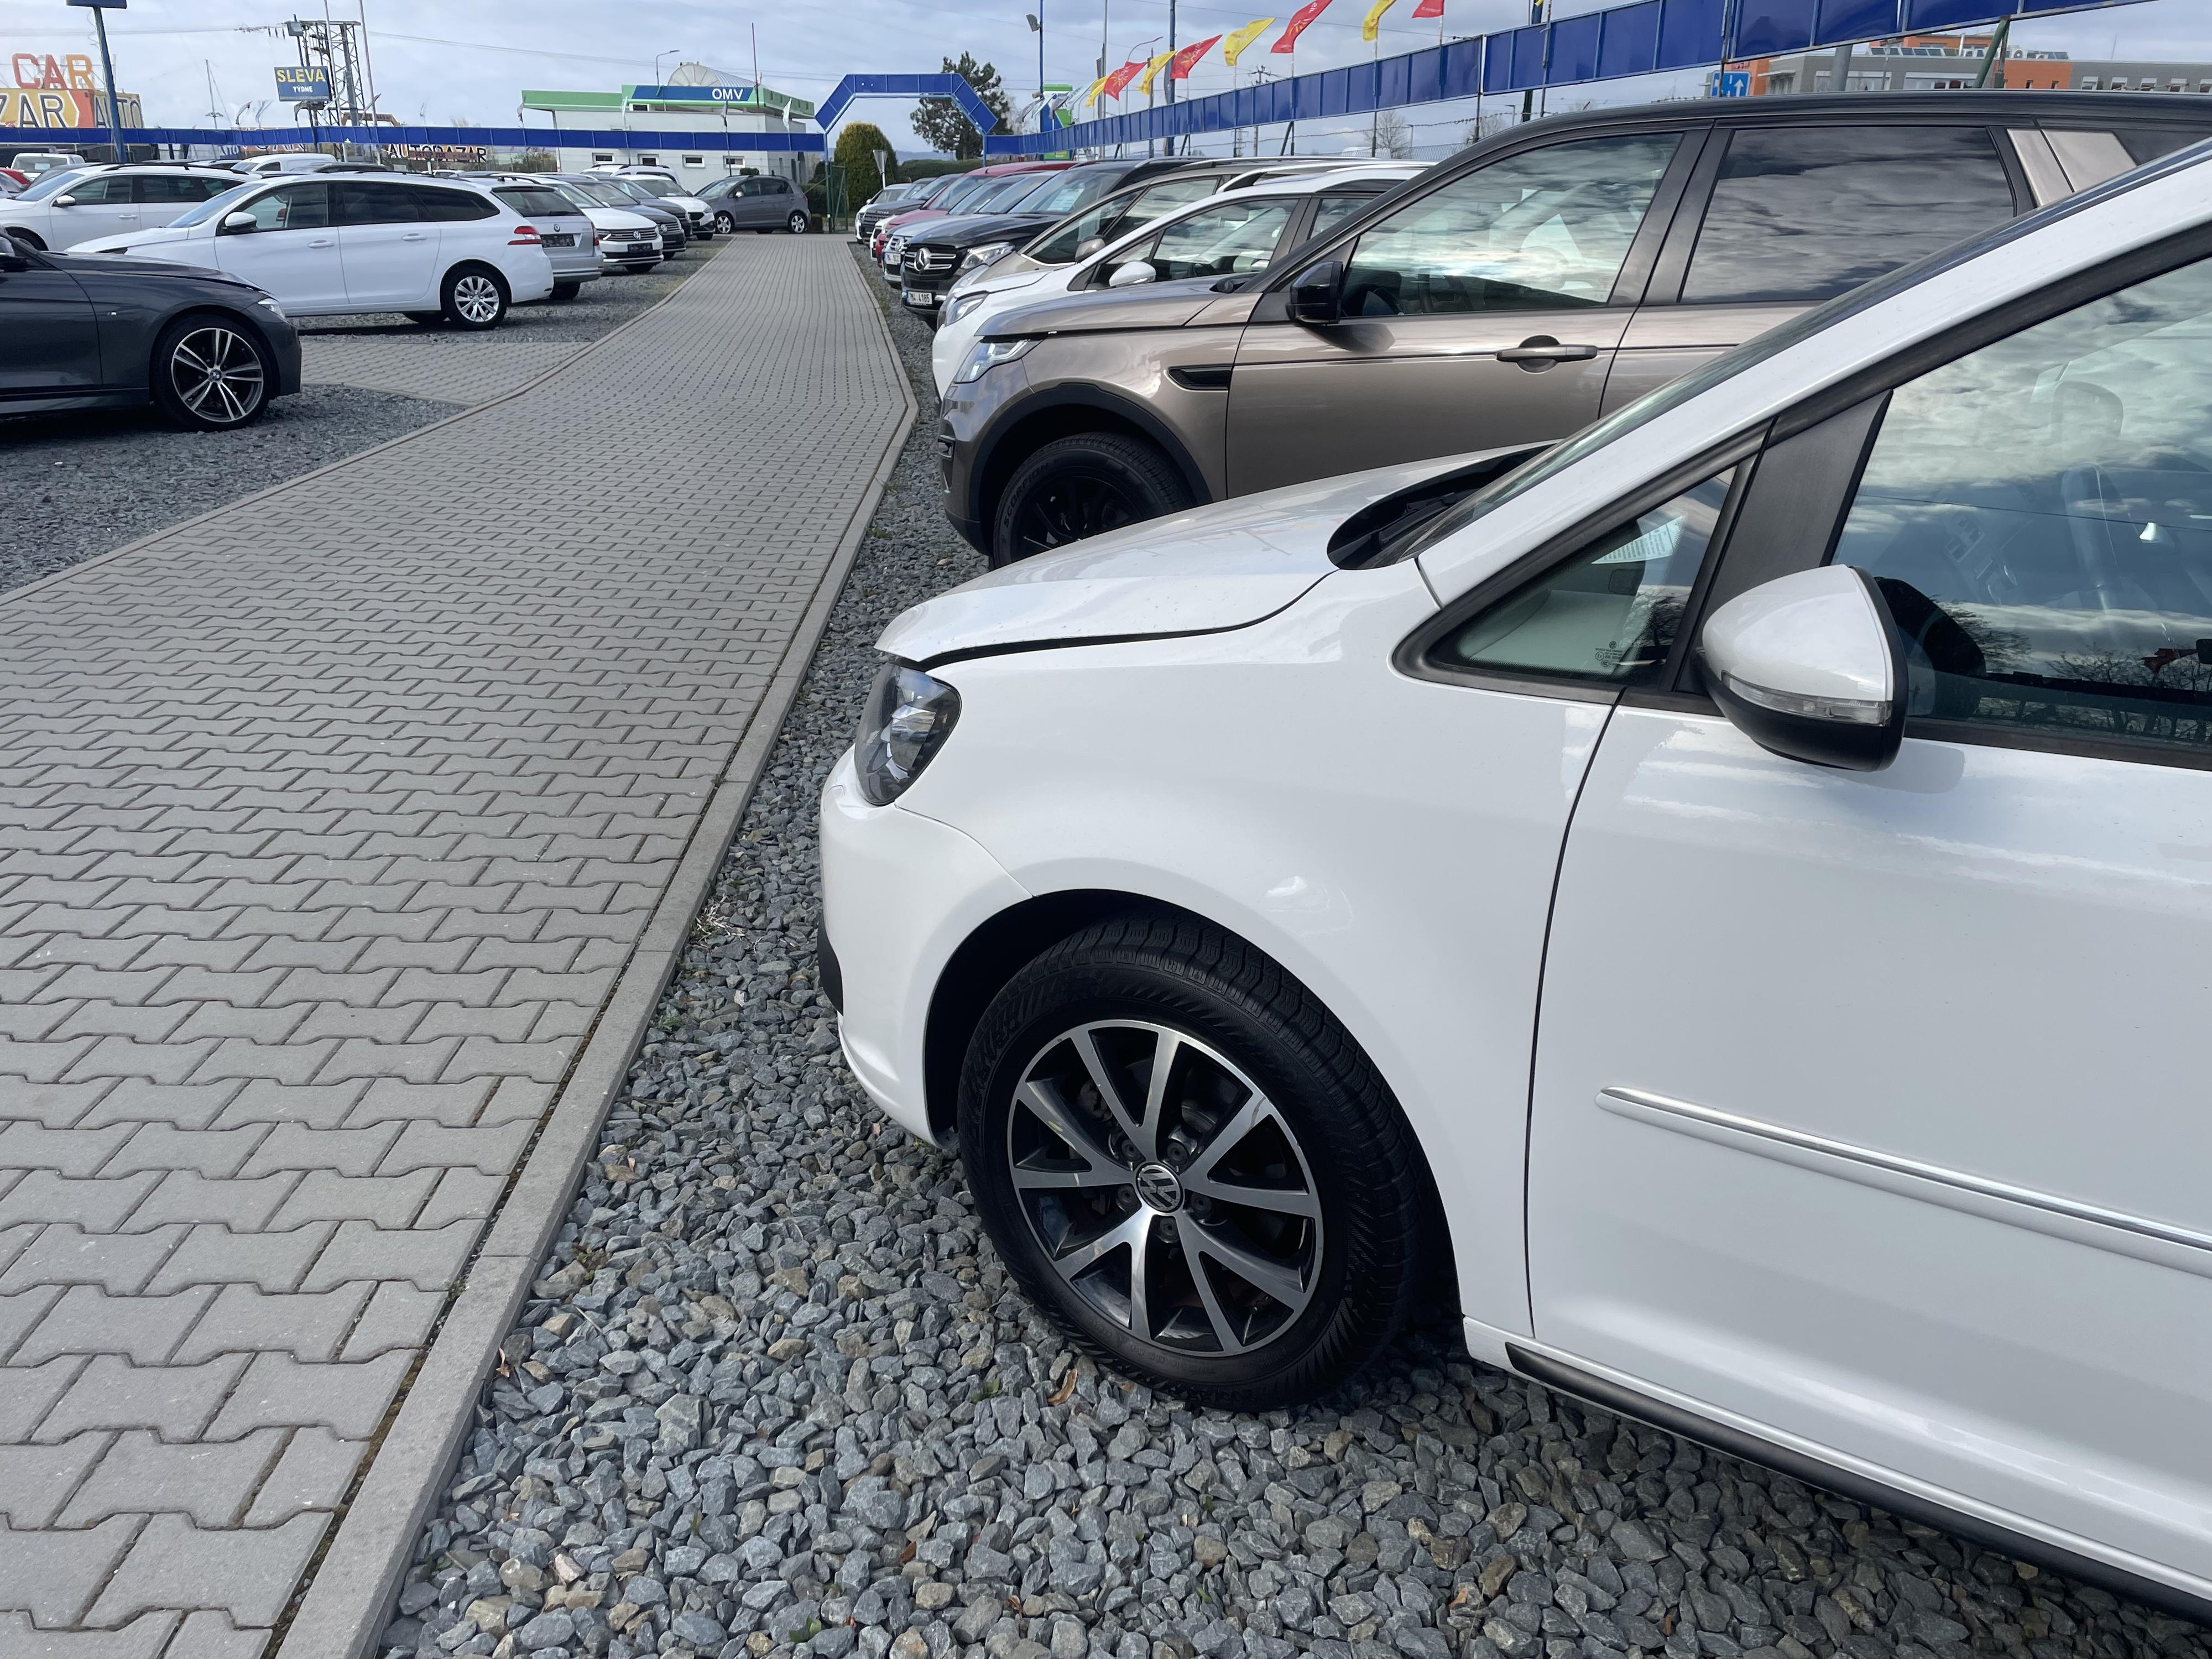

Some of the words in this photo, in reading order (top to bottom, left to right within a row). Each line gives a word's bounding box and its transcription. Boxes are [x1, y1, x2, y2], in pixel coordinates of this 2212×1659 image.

[12, 53, 95, 89] CAR
[277, 69, 326, 82] SLEVA
[712, 88, 744, 100] OMV
[1004, 462, 1050, 528] SCORPION
